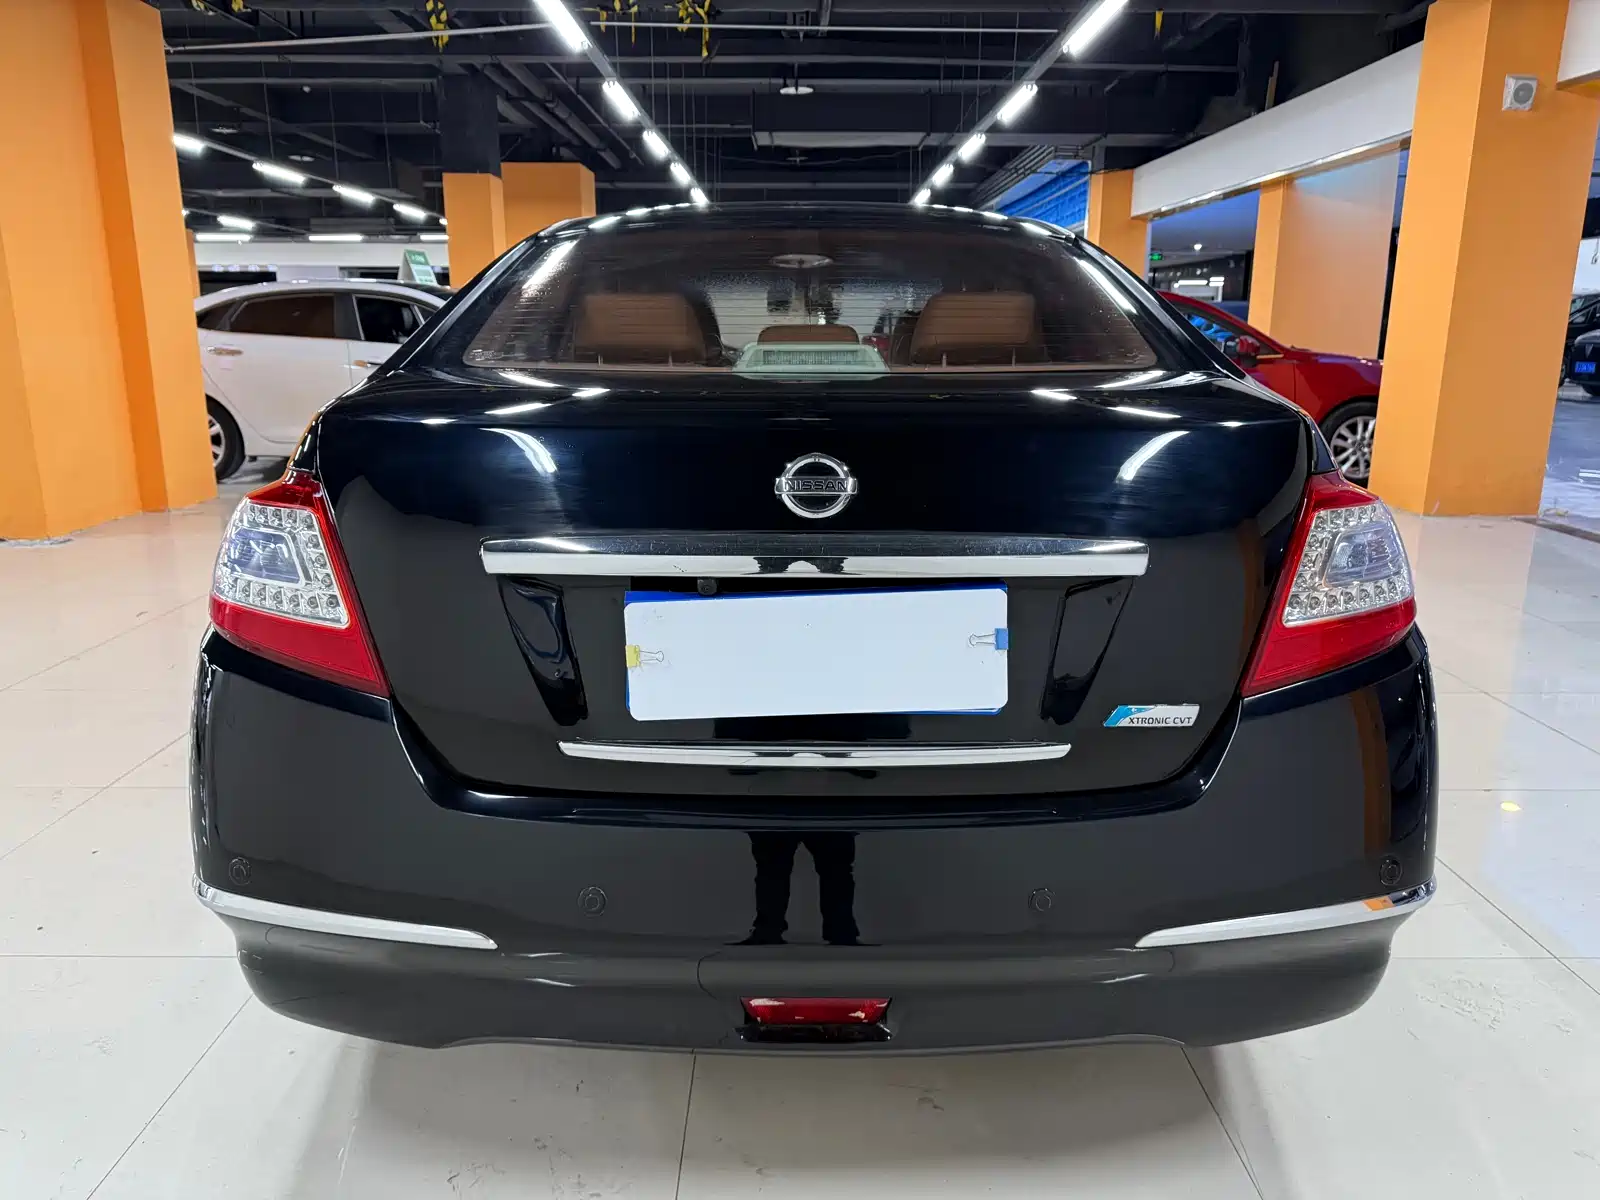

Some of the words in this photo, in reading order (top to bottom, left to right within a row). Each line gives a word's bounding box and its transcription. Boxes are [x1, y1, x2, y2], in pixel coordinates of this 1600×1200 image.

[785, 479, 847, 491] NISSAN
[1128, 717, 1171, 725] XTRONIC
[1172, 717, 1192, 725] CVT
